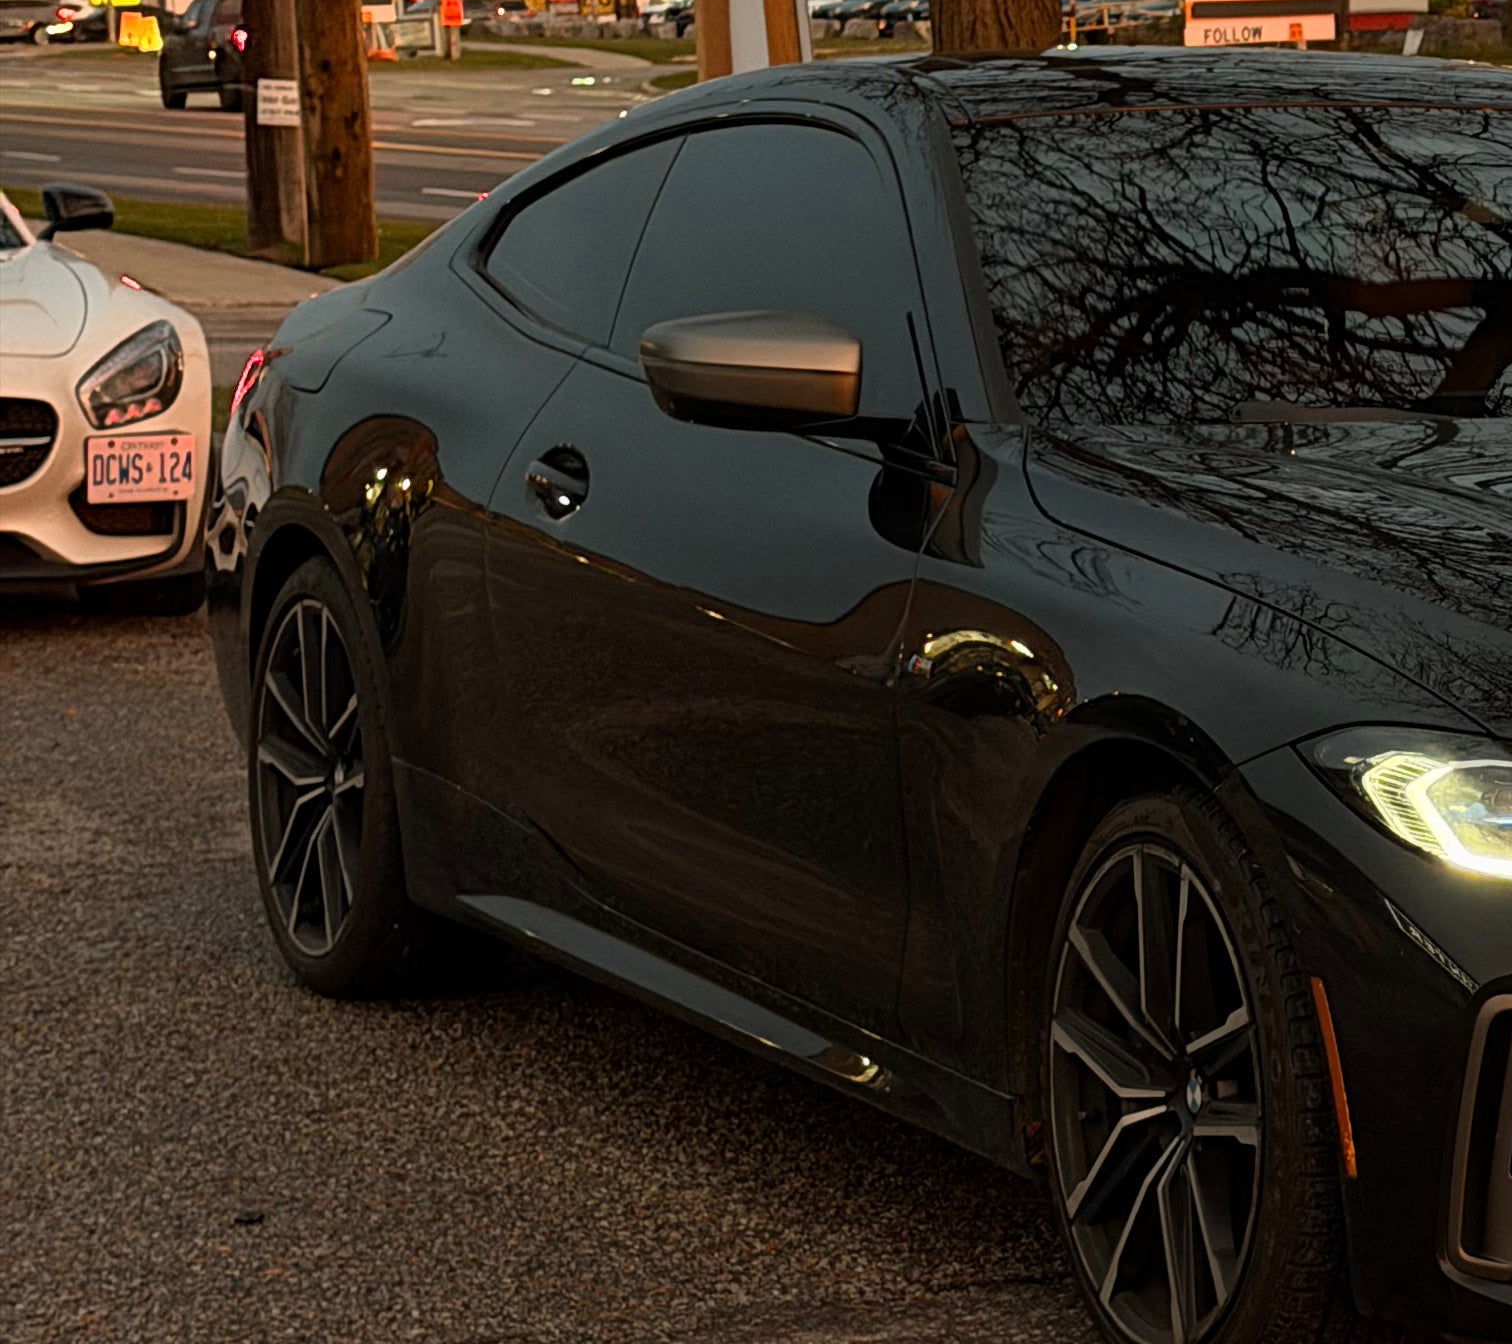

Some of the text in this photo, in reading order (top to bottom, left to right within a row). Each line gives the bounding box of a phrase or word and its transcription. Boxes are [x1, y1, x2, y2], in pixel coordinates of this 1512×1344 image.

[1203, 26, 1263, 44] FOLLOW
[92, 451, 192, 486] DCWS 124
